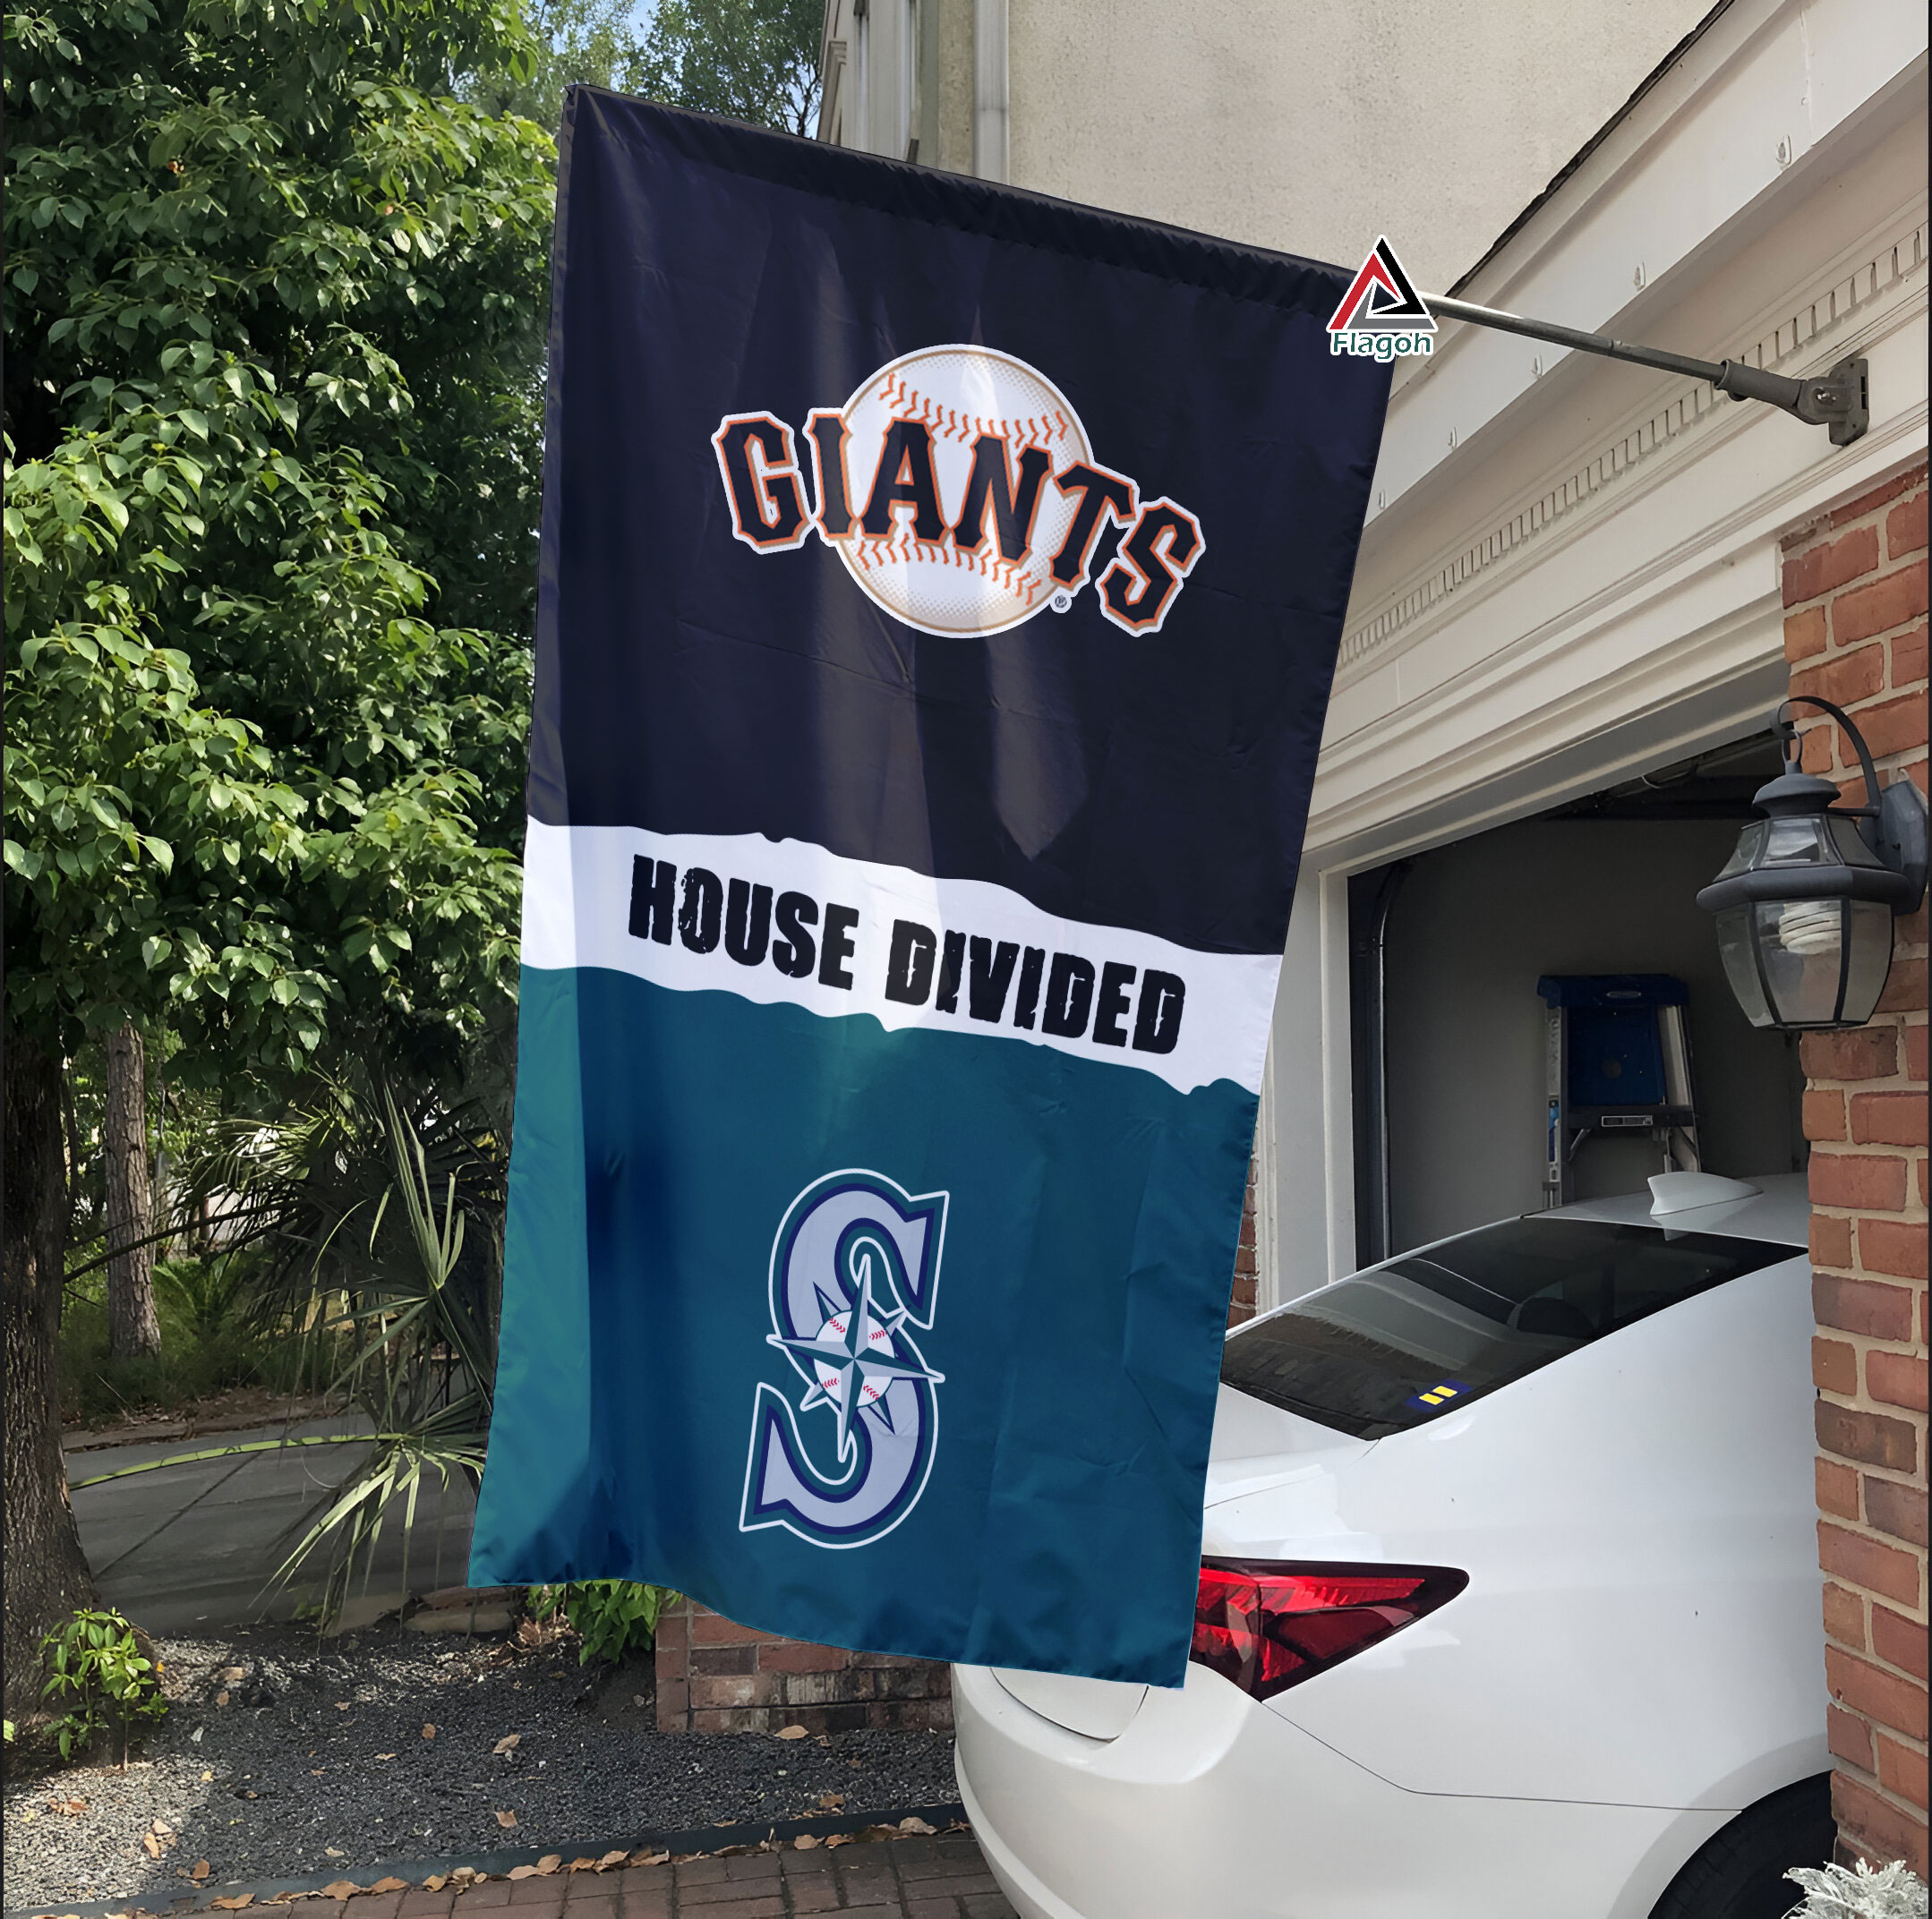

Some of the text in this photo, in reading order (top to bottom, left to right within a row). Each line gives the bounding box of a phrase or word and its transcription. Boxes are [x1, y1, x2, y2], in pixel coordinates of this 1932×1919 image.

[715, 413, 1202, 629] GIANTS
[628, 854, 1186, 1054] HOUSE DIVIDED
[739, 1168, 949, 1548] S
